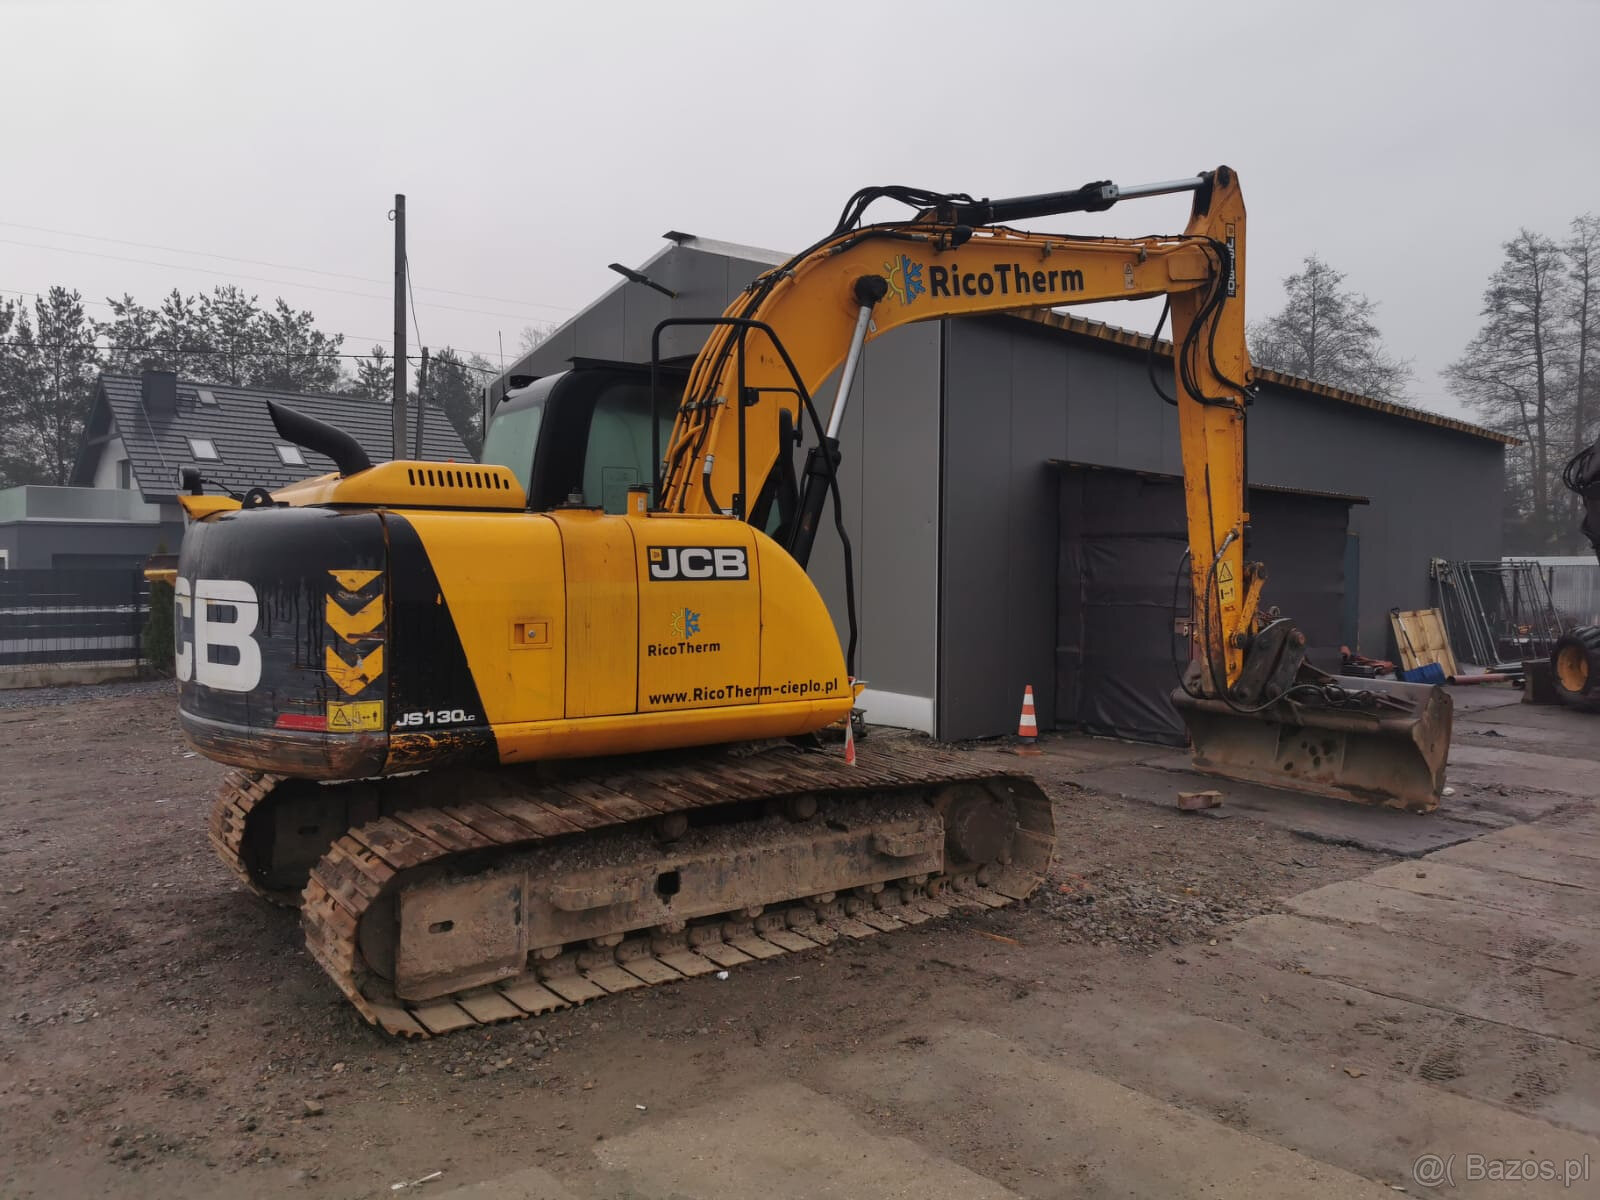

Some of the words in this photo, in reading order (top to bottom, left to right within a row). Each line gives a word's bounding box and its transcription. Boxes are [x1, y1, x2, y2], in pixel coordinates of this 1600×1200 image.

[929, 263, 1084, 297] RicoTherm
[650, 548, 747, 578] JCB
[647, 642, 721, 657] RicoTherm
[648, 678, 838, 705] www.RicoTherm-cieplo.pl
